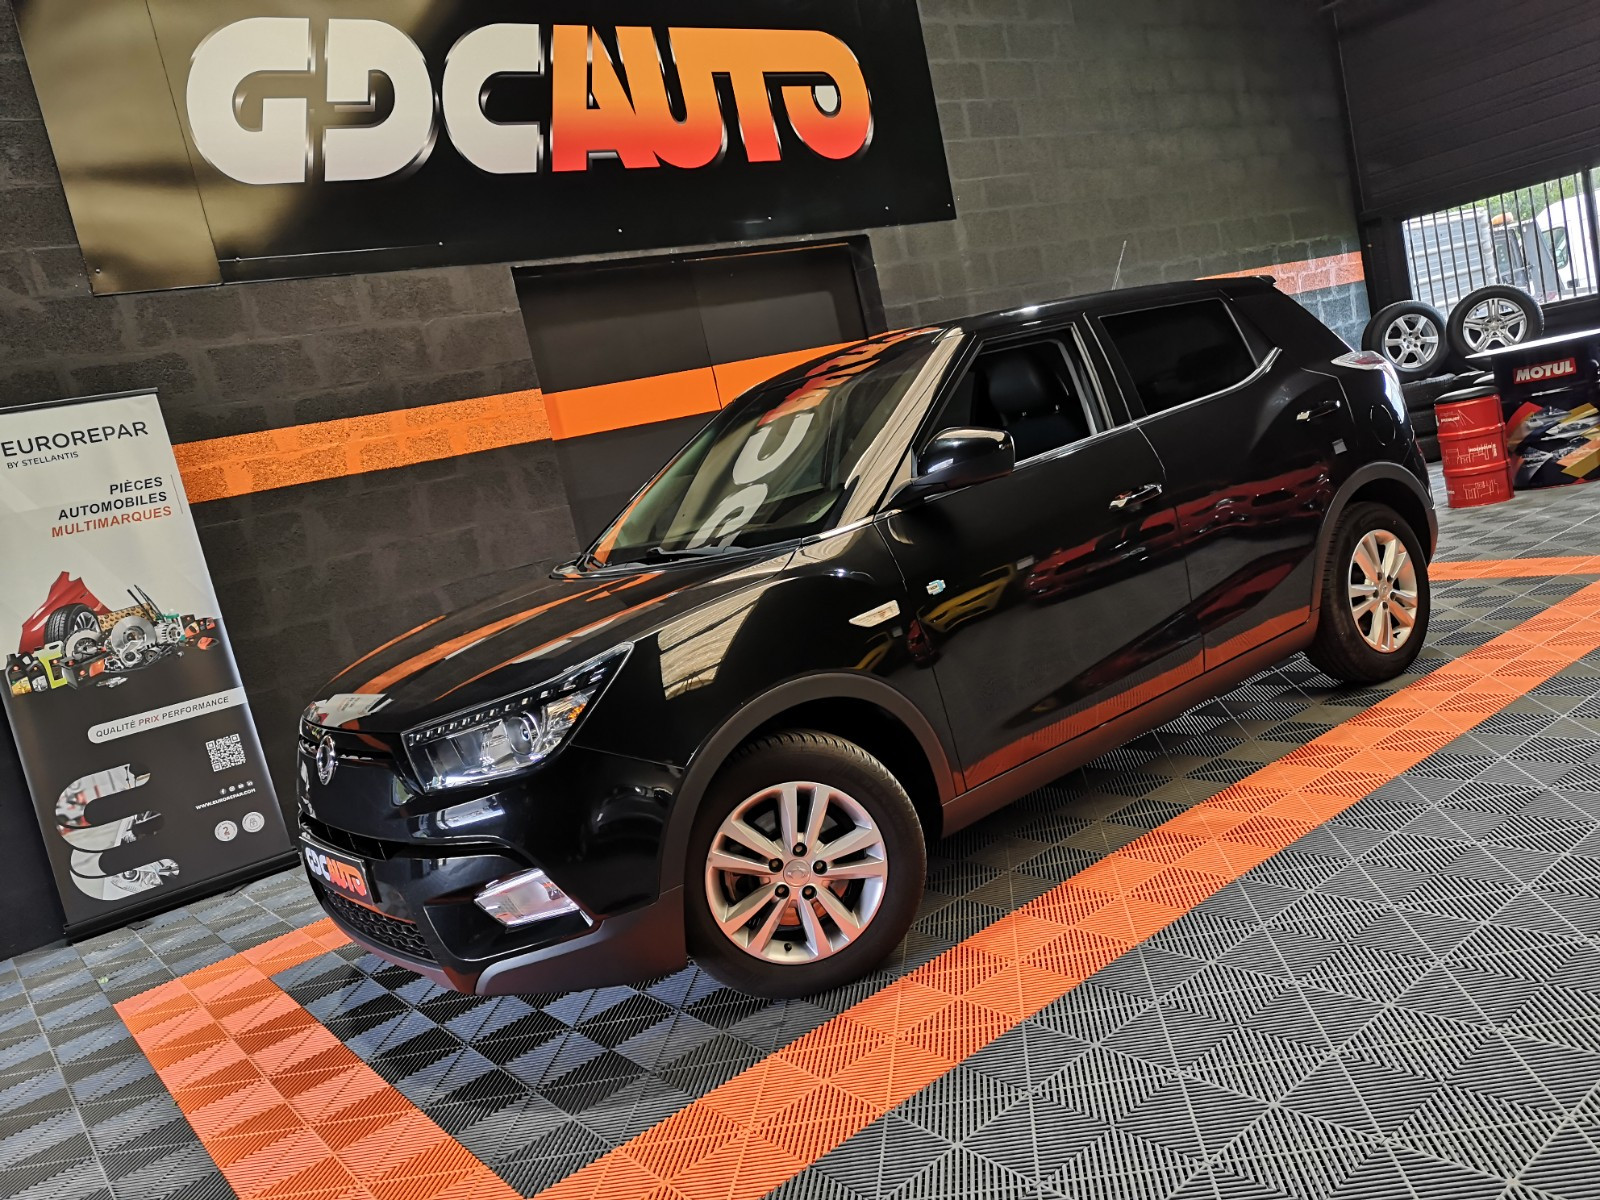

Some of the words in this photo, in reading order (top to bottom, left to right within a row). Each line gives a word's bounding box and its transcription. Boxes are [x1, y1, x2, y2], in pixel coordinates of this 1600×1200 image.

[1515, 359, 1574, 383] MOTUL
[1, 421, 148, 457] EUROREPAR
[7, 461, 19, 469] BY
[21, 451, 79, 467] STELLANTIS
[109, 476, 163, 495] PIÈCES
[58, 491, 167, 520] AUTOMOBILES
[51, 505, 172, 538] MULTIMARQUES
[96, 719, 136, 738] QUALITÉ
[138, 714, 160, 727] PRIX
[162, 696, 229, 720] PERFORMANCE
